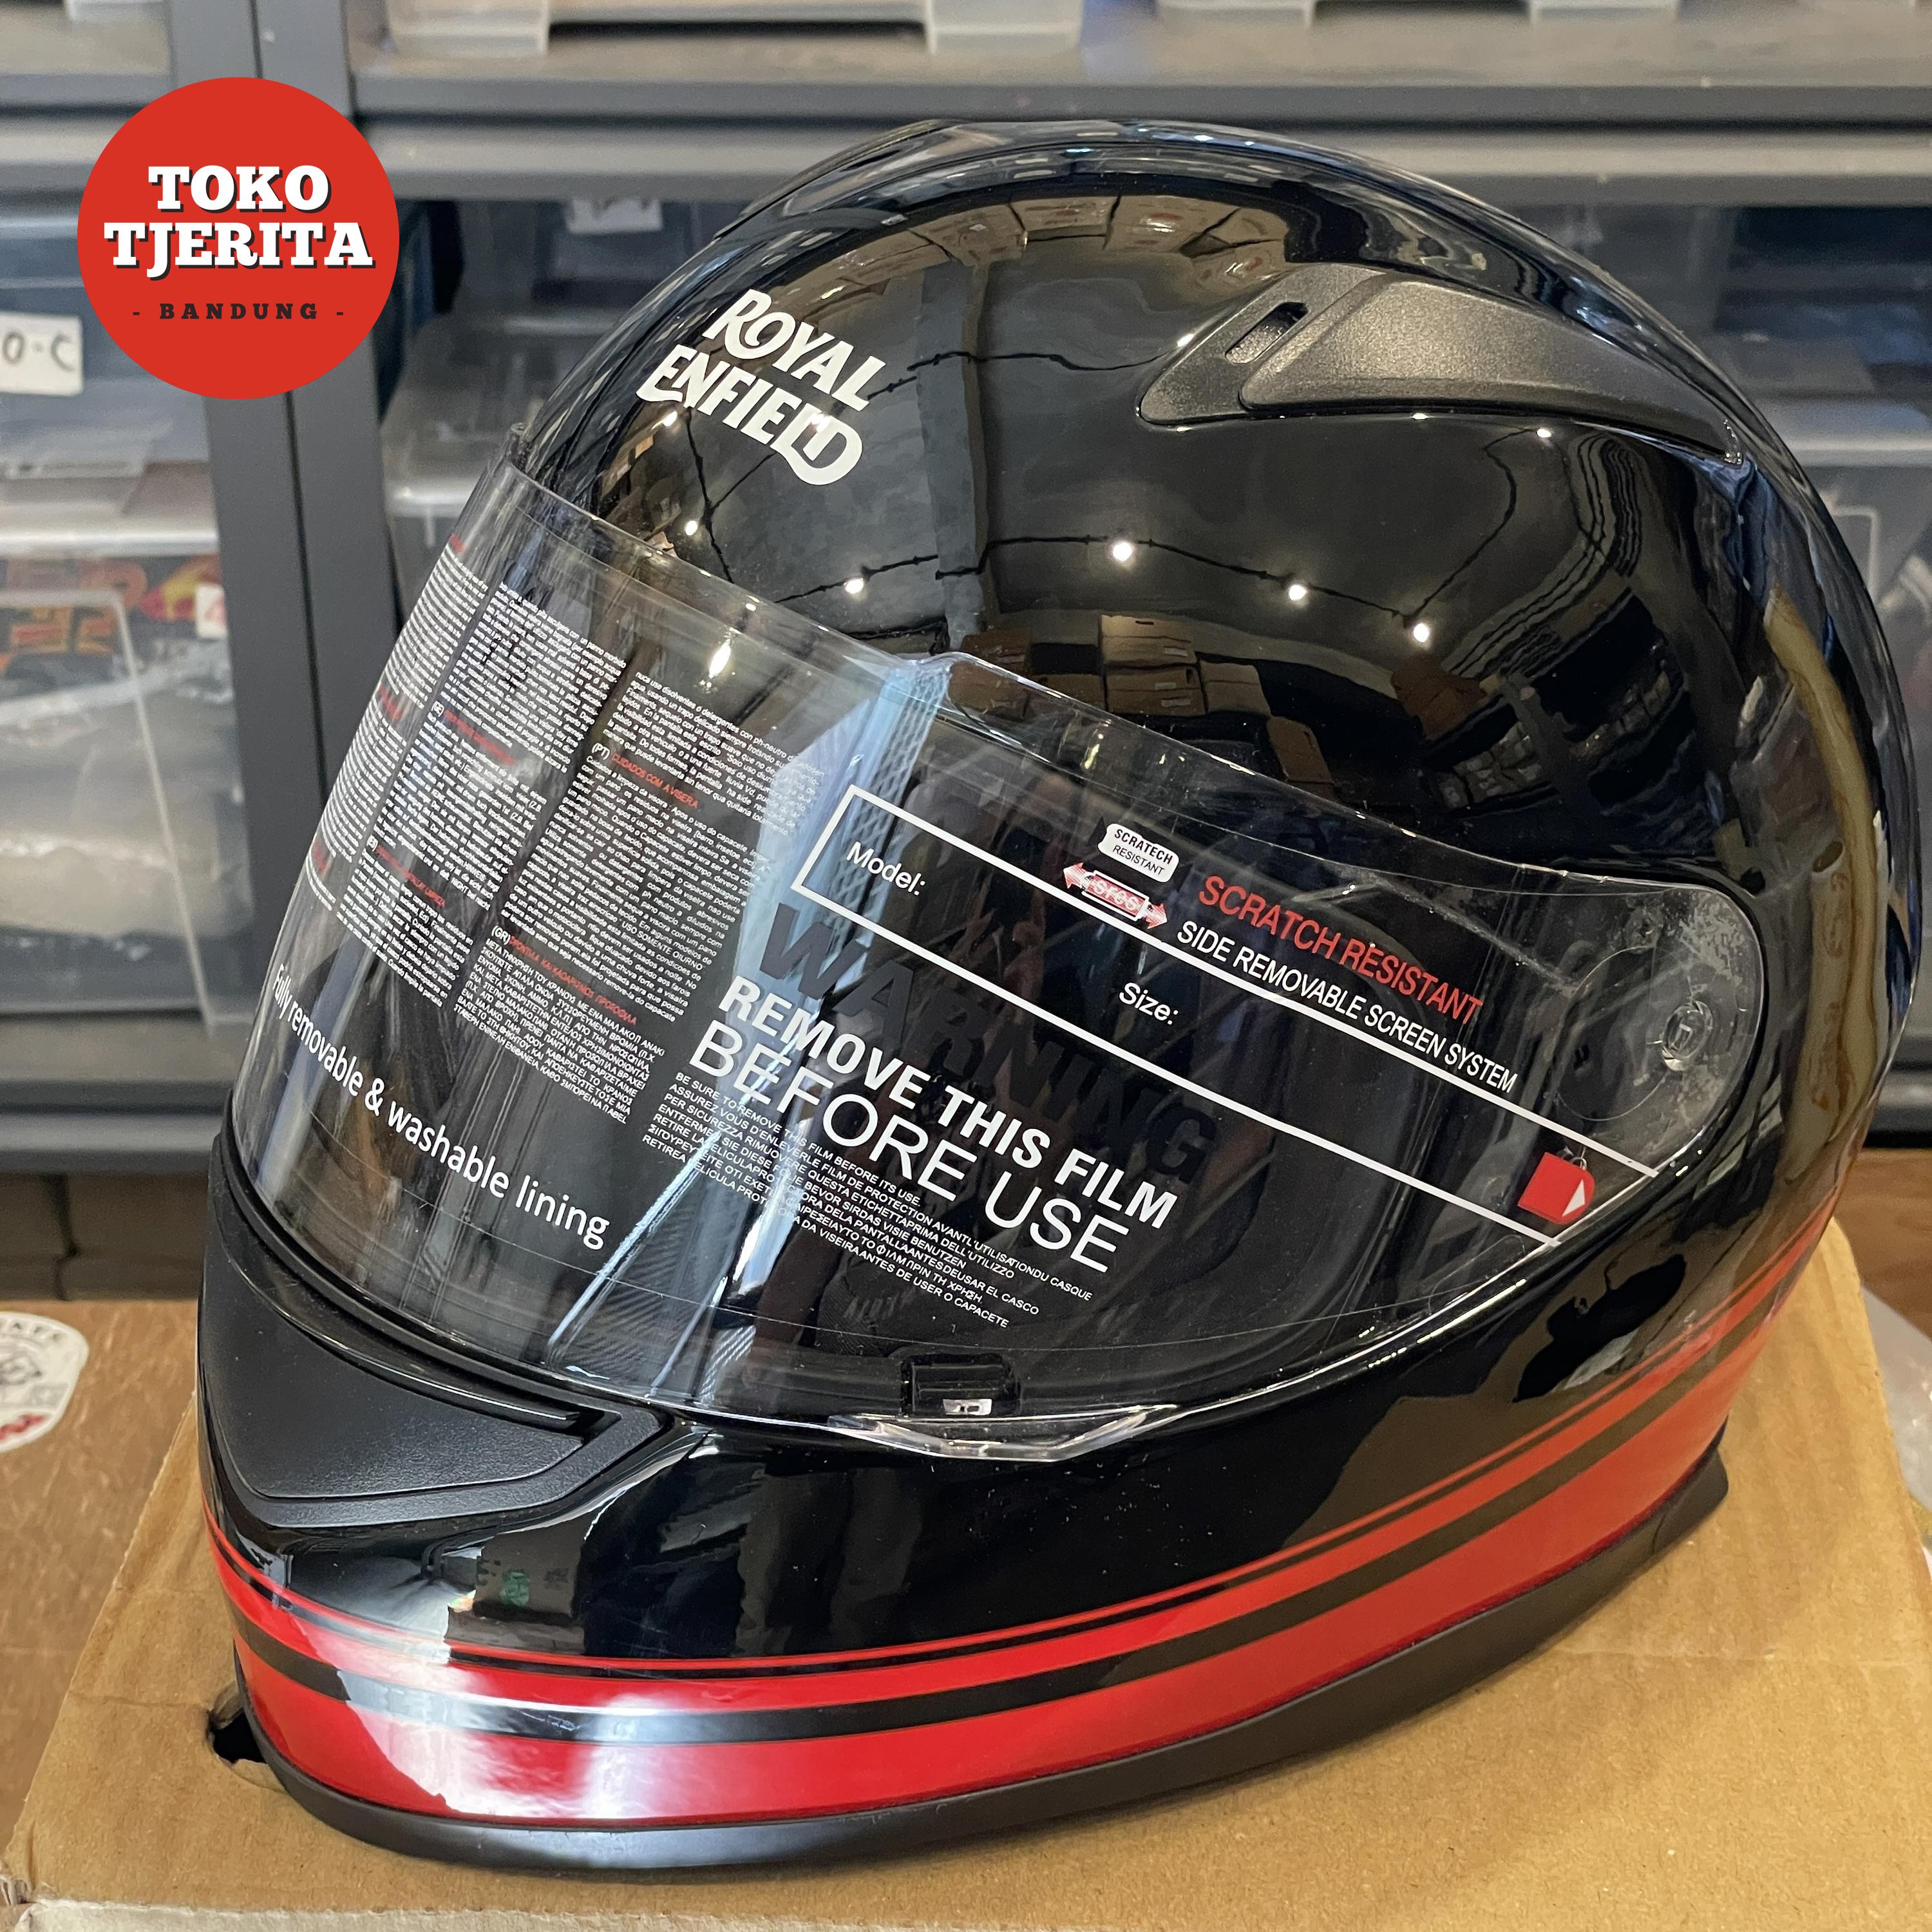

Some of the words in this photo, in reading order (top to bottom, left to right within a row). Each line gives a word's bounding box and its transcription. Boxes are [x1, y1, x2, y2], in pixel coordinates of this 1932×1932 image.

[636, 344, 862, 486] ENFIELD
[702, 289, 886, 412] ROYAL
[846, 842, 925, 896] Model:
[1113, 845, 1164, 875] RESISTANT
[1114, 829, 1173, 864] SCRATECH
[490, 924, 512, 946] (GR)
[1119, 982, 1179, 1025] Size:
[1177, 921, 1235, 963] SIDE
[1233, 946, 1367, 1019] REMOVABLE
[1364, 1004, 1447, 1058] SCREEN
[1444, 1043, 1518, 1094] SYSTEM
[1199, 875, 1341, 959] SCRATCH
[1339, 939, 1483, 1025] RESISTANT
[272, 964, 290, 1019] Fully
[289, 1003, 364, 1097] removable
[365, 1077, 384, 1117] &
[388, 1101, 509, 1198] washable
[515, 1175, 611, 1249] lining
[719, 976, 930, 1110] REMOVE
[933, 1085, 1051, 1168] THIS
[1053, 1149, 1178, 1230] FILM
[759, 902, 1220, 1188] WARNING
[652, 1112, 691, 1138] RETIRE
[690, 1133, 706, 1146] LA
[985, 1285, 1001, 1298] EL
[1000, 1292, 1040, 1316] CASCO
[663, 1092, 687, 1110] PER
[686, 1104, 745, 1141] SICUREZZA
[744, 1135, 808, 1175] RIMUOVERE
[806, 1168, 851, 1198] QUESTA
[940, 1237, 1016, 1279] DELL'UTILIZZO
[668, 1082, 719, 1113] ASSUREZ
[718, 1108, 750, 1130] VOUS
[820, 1162, 847, 1182] FILM
[846, 1176, 864, 1191] DE
[863, 1185, 933, 1226] PROTECTION
[1050, 1277, 1093, 1302] CASQUE
[674, 1072, 691, 1086] BE
[690, 1079, 721, 1101] SURE
[721, 1095, 738, 1110] TO
[736, 1104, 782, 1133] REMOVE
[781, 1128, 808, 1148] THIS
[807, 1142, 834, 1161] FILM
[833, 1155, 878, 1185] BEFORE
[878, 1179, 897, 1195] ITS
[896, 1188, 923, 1208] USE.
[690, 1020, 978, 1201] BEFORE
[985, 1172, 1129, 1273] USE
[721, 1136, 740, 1152] SIE
[739, 1146, 772, 1169] DIESE
[803, 1180, 842, 1206] BEVOR
[841, 1200, 882, 1227] SIRDAS
[881, 1221, 910, 1241] VISIE
[909, 1235, 967, 1269] BENUTZEN
[641, 1133, 688, 1163] RETIREA
[800, 1218, 819, 1234] DA
[895, 1267, 913, 1282] DE
[912, 1276, 943, 1297] USER
[942, 1291, 954, 1303] O
[952, 1297, 1009, 1329] CAPACETE
